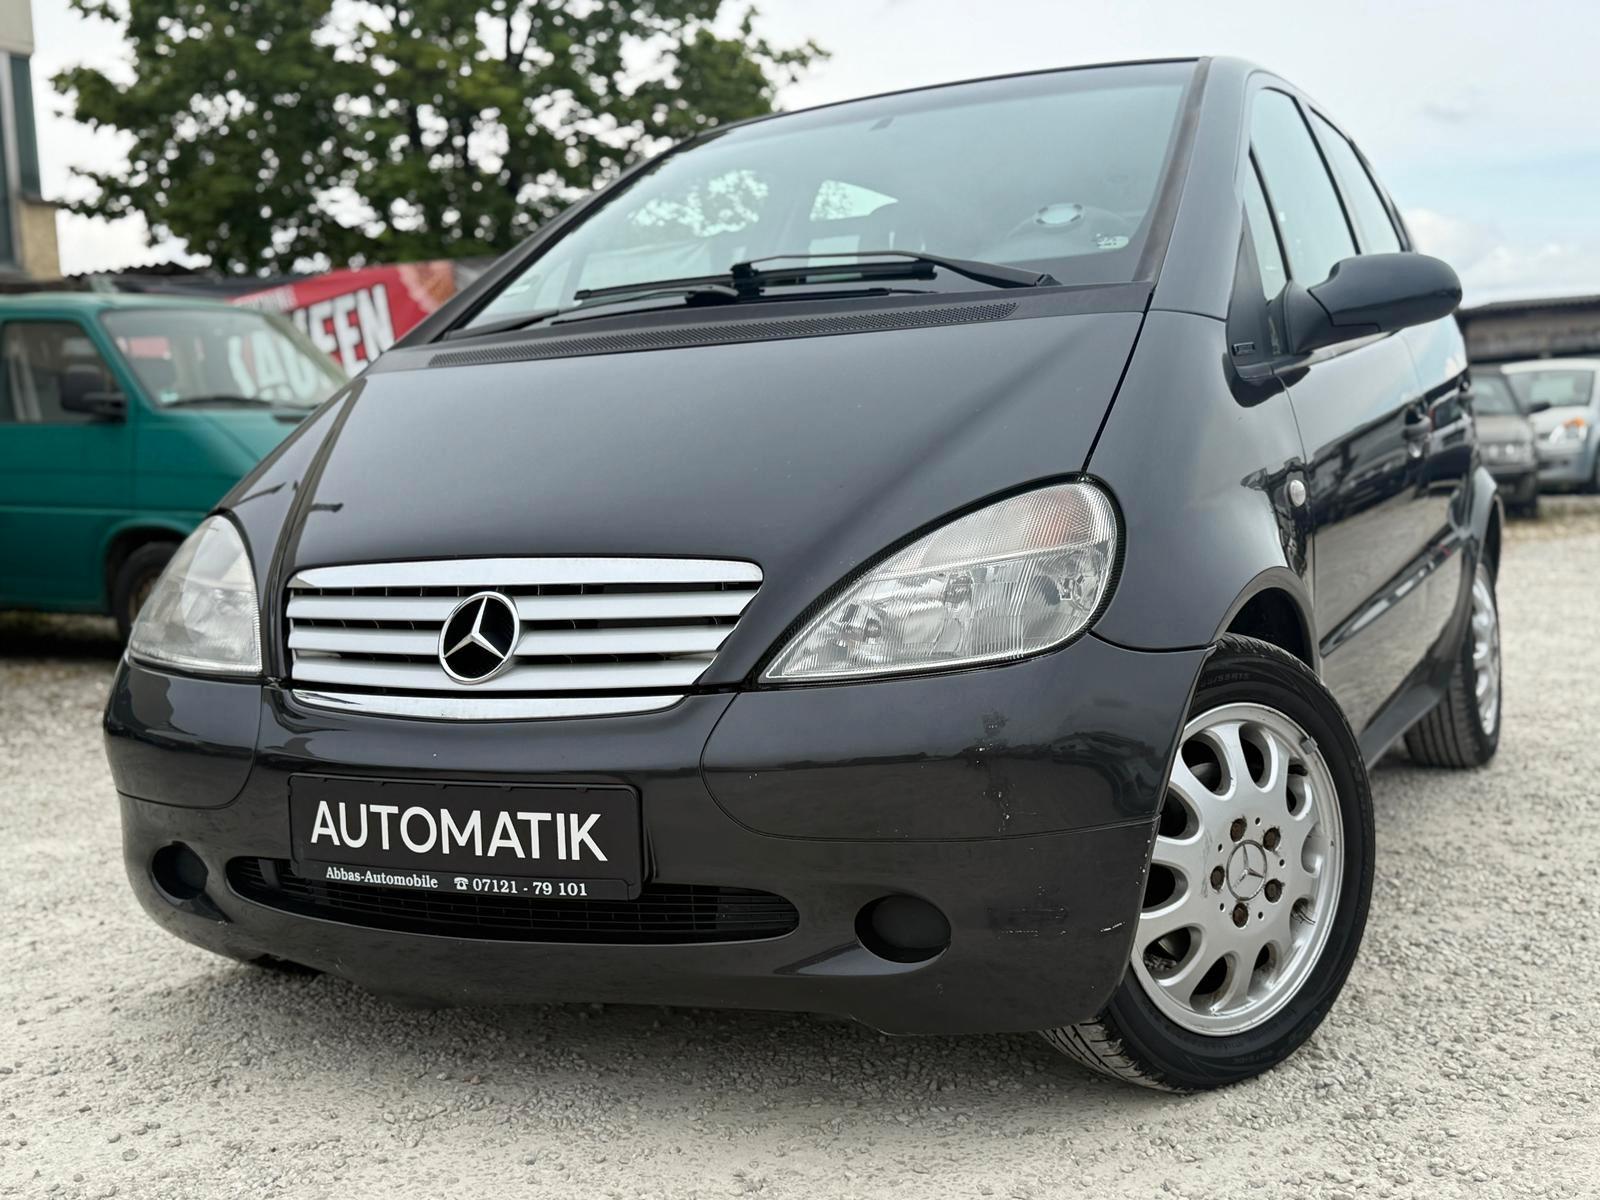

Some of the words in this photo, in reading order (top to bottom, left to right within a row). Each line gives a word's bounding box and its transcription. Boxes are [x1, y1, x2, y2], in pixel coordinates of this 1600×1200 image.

[310, 800, 608, 862] AUTOMATIK
[326, 866, 439, 889] Abbas-Automobile
[473, 878, 518, 894] 07121
[533, 881, 553, 895] 79
[559, 882, 588, 896] 101
